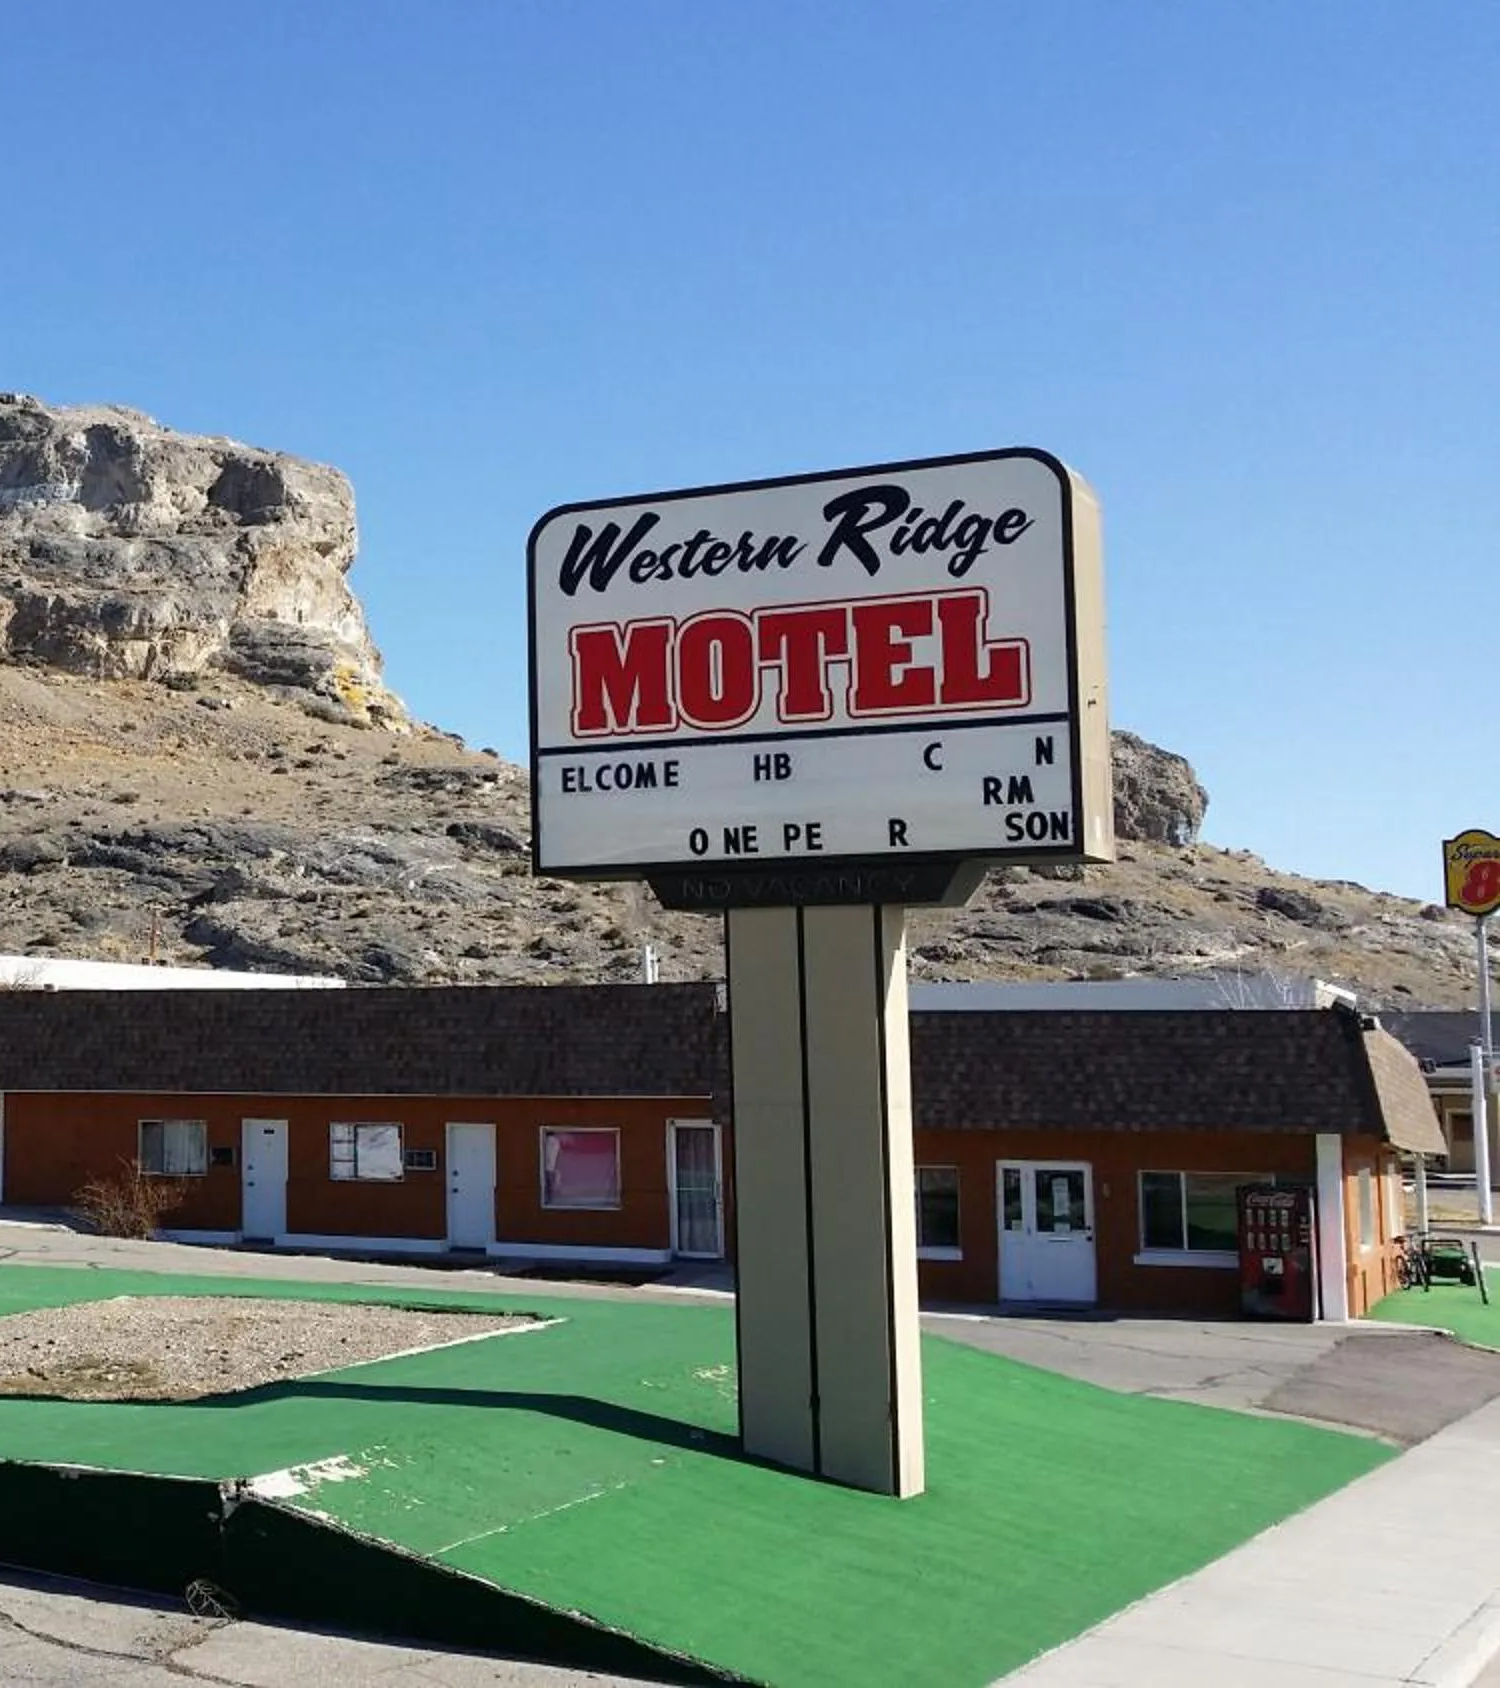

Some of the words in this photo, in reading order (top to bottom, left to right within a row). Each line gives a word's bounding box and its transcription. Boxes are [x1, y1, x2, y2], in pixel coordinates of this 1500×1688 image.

[559, 512, 807, 596] Western
[817, 485, 1034, 577] Ridge
[571, 587, 1031, 736] MOTEL
[562, 760, 679, 793] ELCOME
[754, 752, 791, 781] HB
[924, 742, 942, 770] C
[1036, 736, 1054, 765] N
[983, 776, 1034, 805] RM
[1005, 811, 1069, 842] SON
[680, 877, 731, 899] NO
